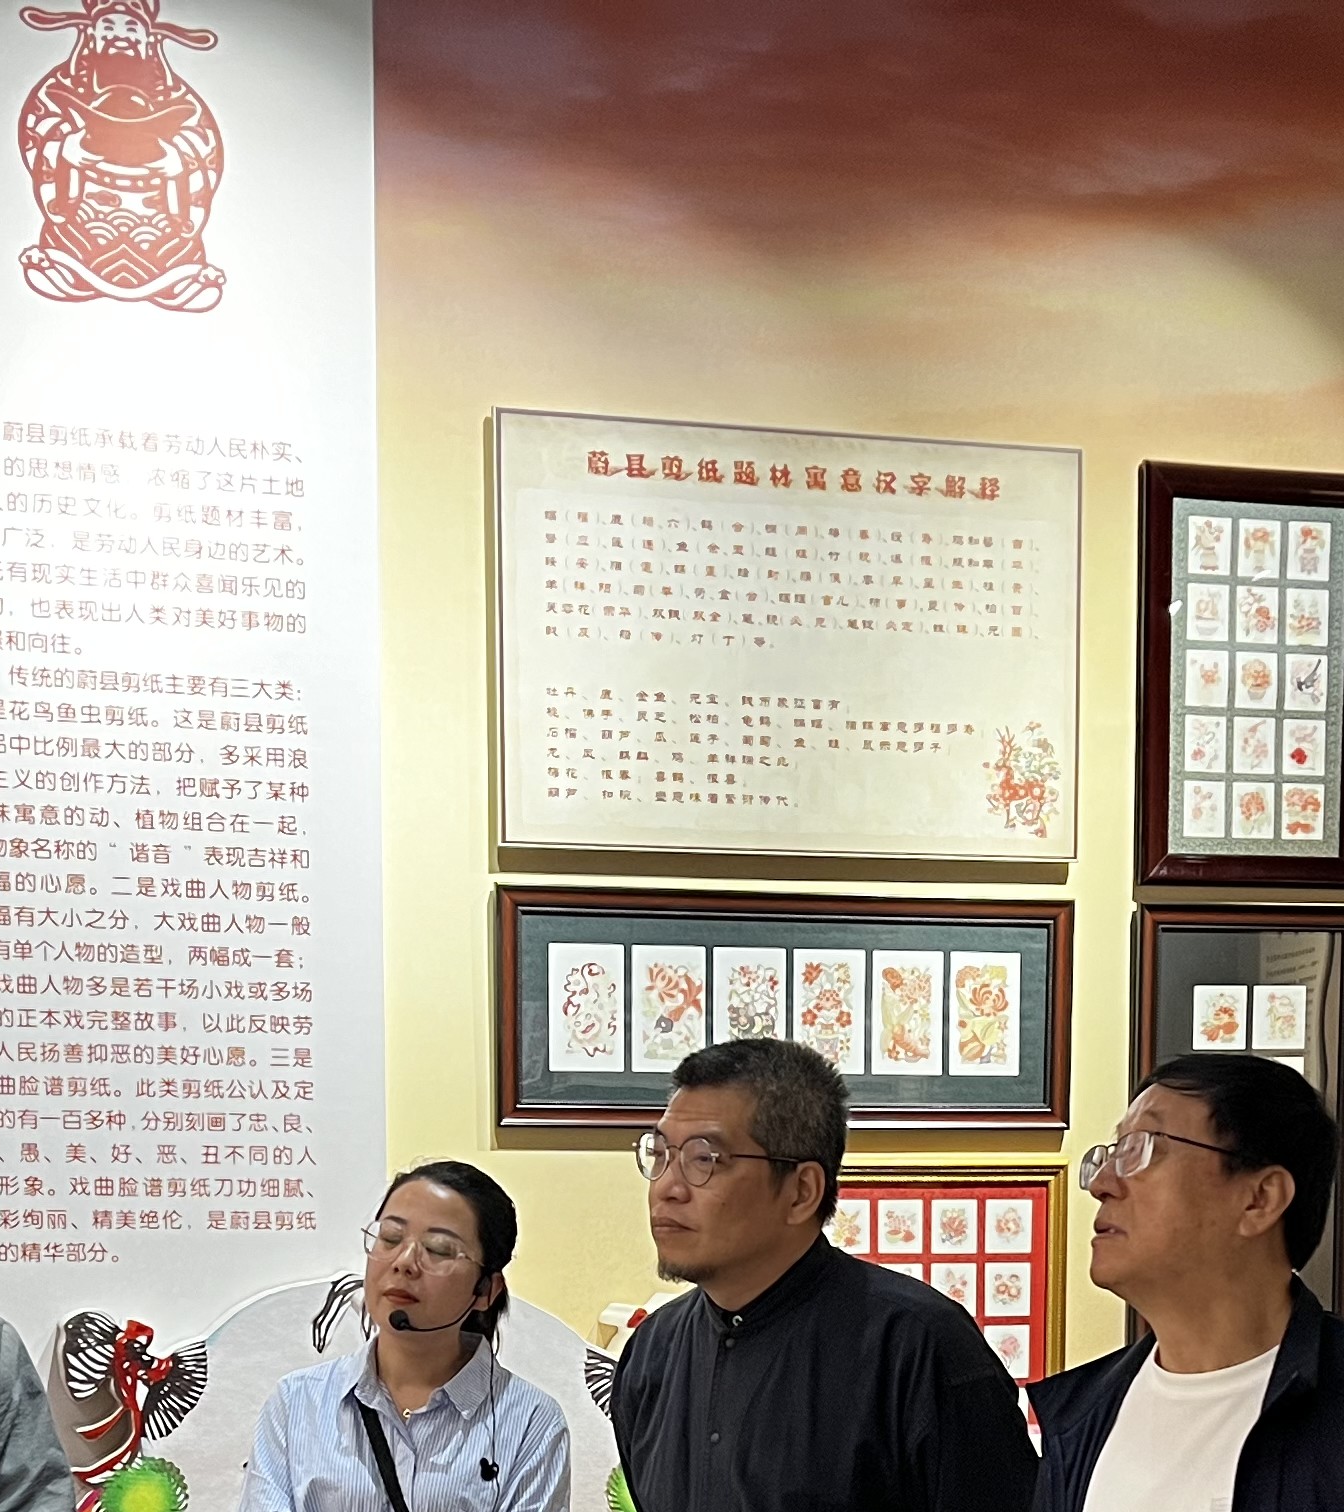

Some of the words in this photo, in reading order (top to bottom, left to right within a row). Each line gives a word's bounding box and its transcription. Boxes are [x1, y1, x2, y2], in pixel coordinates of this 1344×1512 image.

[3, 421, 302, 463] 蔚县剪纸承载着劳动人民朴实、
[586, 449, 1002, 501] 蔚县剪纸题材寓意汉字解释
[8, 664, 301, 702] 传统的蔚县剪纸主要有三大类：
